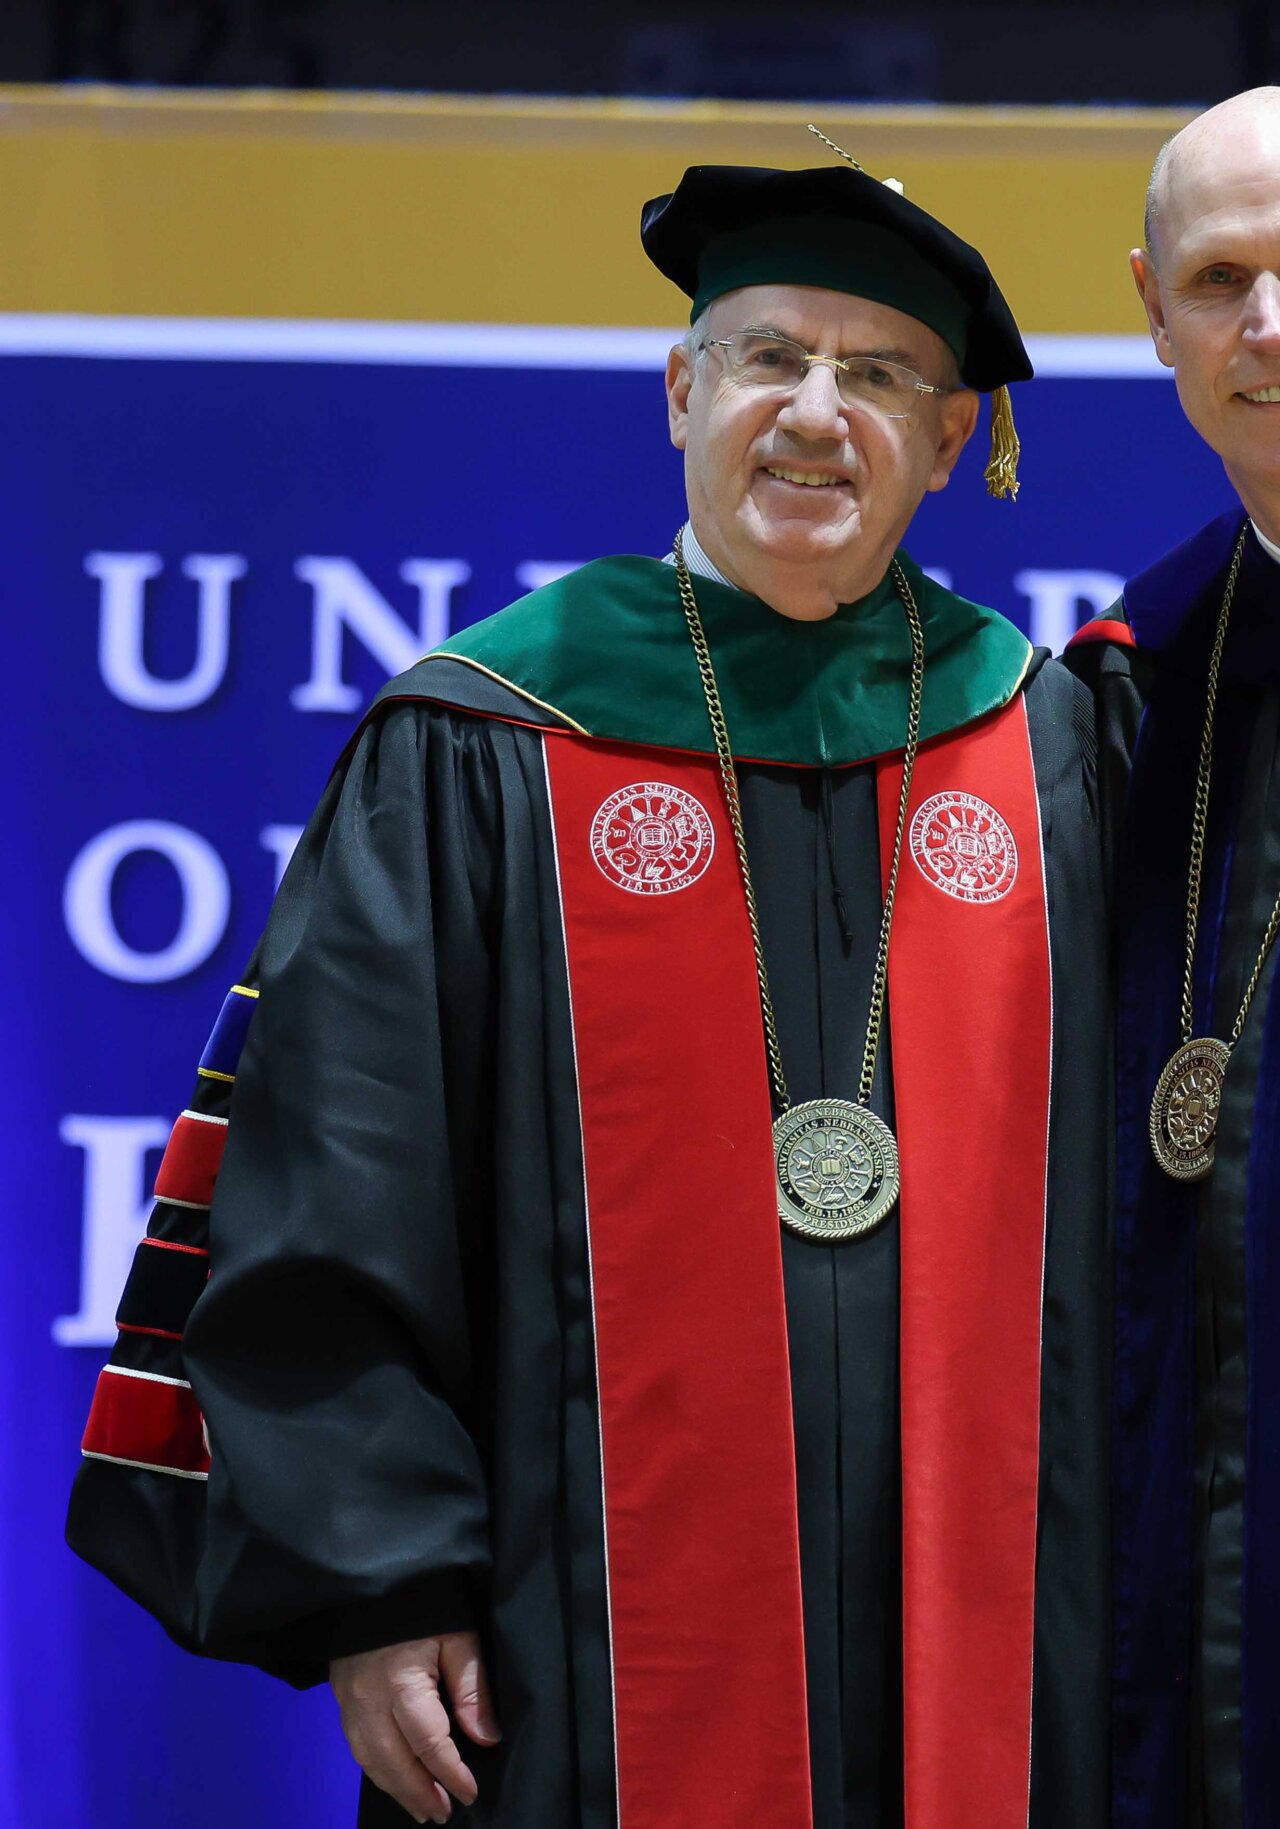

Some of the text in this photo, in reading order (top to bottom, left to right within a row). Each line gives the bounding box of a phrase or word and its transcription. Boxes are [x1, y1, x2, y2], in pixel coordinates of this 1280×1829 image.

[592, 787, 637, 857] UNIVERSITAS
[644, 785, 712, 847] NEBRASKENSIS
[912, 794, 955, 856] UNIVERSITAS
[778, 1119, 819, 1184] UNIVERSITAS
[823, 1118, 883, 1176] NEBRASKENSIS
[796, 1110, 812, 1124] OF
[815, 1106, 877, 1134] NEBRASKA
[875, 1133, 896, 1180] SYSTEM
[803, 1209, 870, 1230] PRESIDENT
